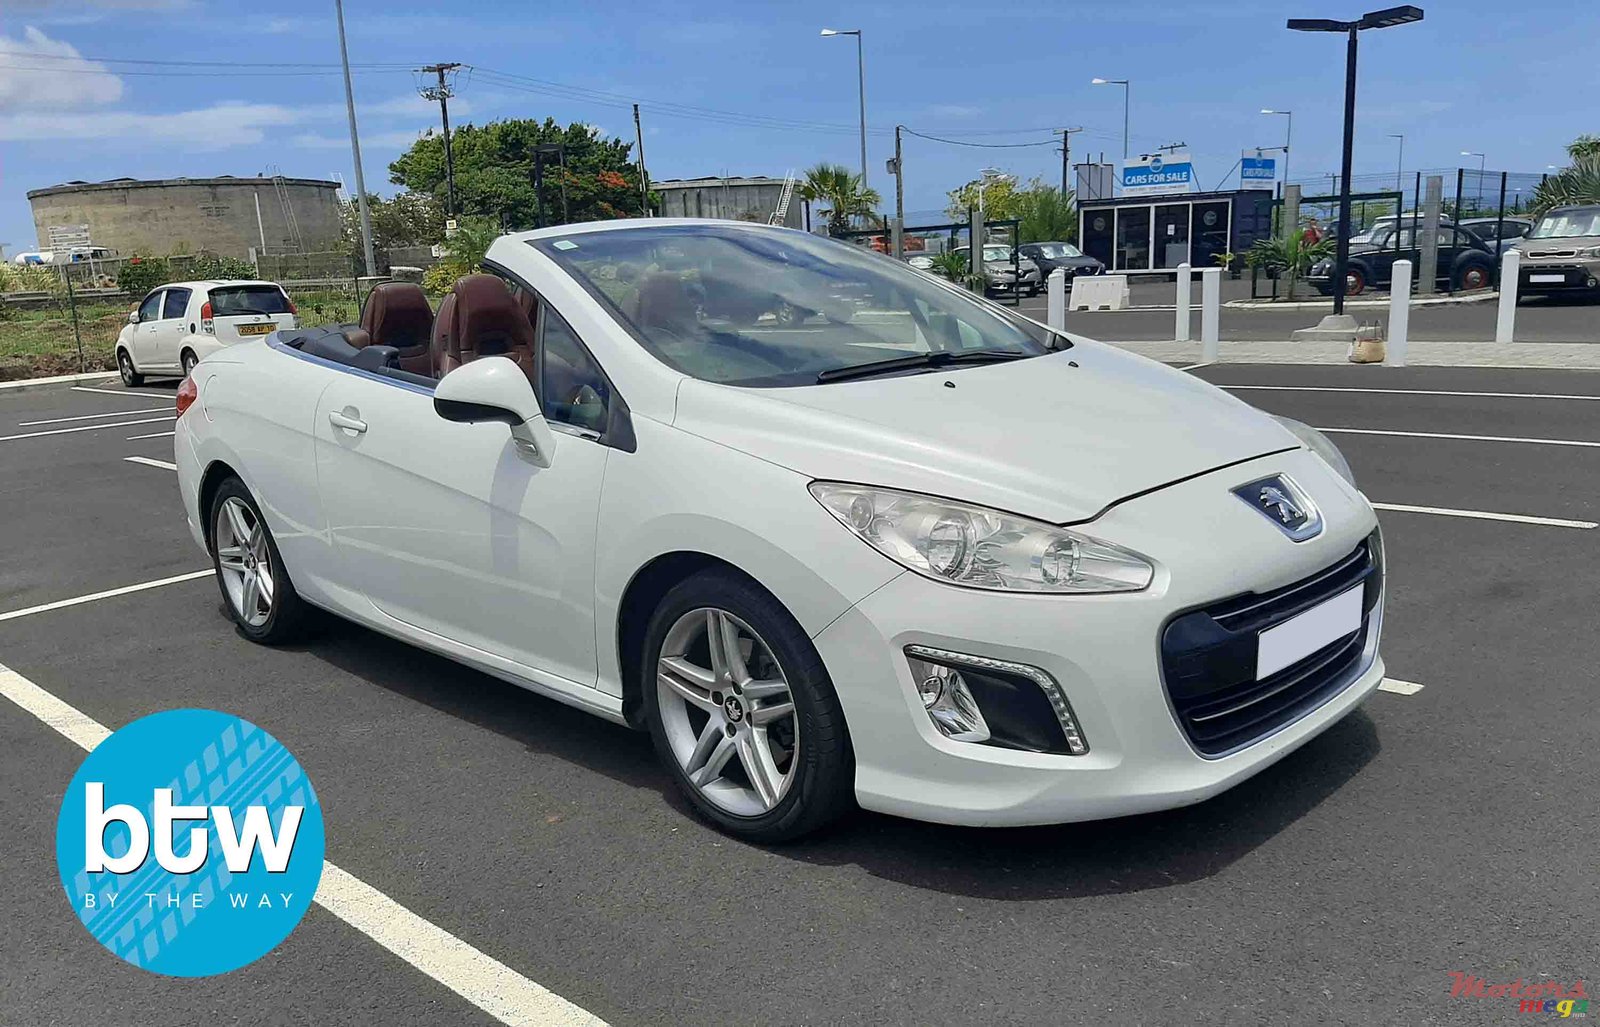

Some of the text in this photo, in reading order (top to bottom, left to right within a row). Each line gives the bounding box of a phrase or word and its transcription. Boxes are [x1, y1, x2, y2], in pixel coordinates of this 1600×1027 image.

[1125, 171, 1188, 185] CARS FOR SALE
